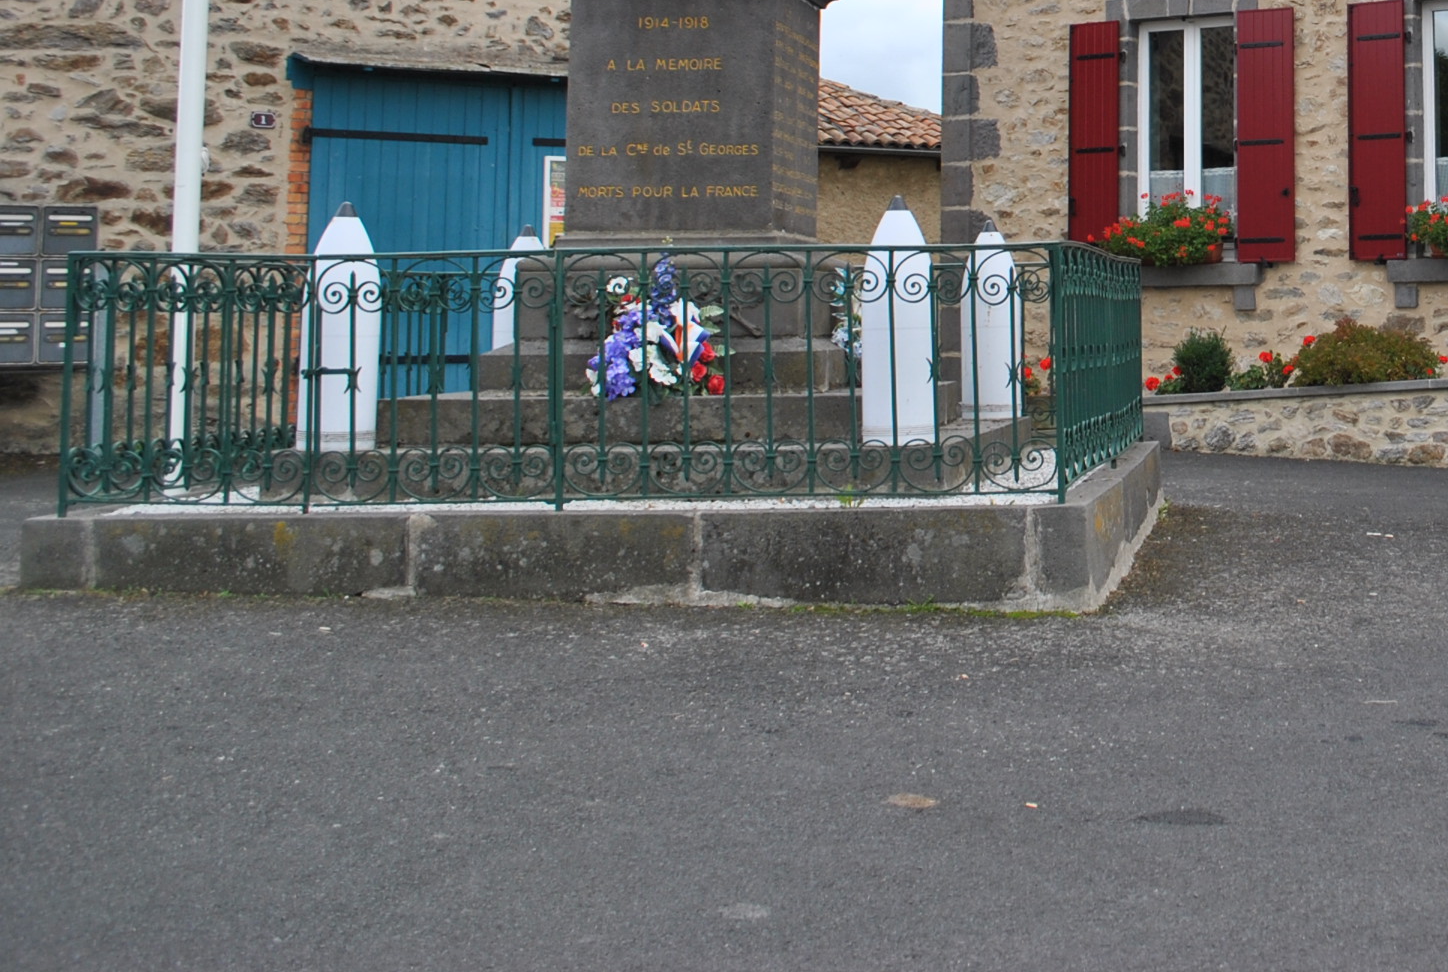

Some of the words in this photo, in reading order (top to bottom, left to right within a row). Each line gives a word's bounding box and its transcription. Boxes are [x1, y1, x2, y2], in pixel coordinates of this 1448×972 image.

[637, 16, 710, 30] 1914-1918
[606, 58, 616, 71] A
[626, 58, 646, 71] LA
[655, 57, 723, 71] MEMOIRE
[611, 101, 640, 115] DES
[650, 100, 720, 114] SOLDATS
[577, 145, 595, 156] DE
[601, 145, 618, 157] LA
[653, 142, 671, 156] de
[699, 142, 759, 156] GEORGES
[577, 185, 624, 198] MORTS
[632, 185, 673, 198] POUR
[681, 185, 699, 197] LA
[706, 184, 759, 197] FRANCE
